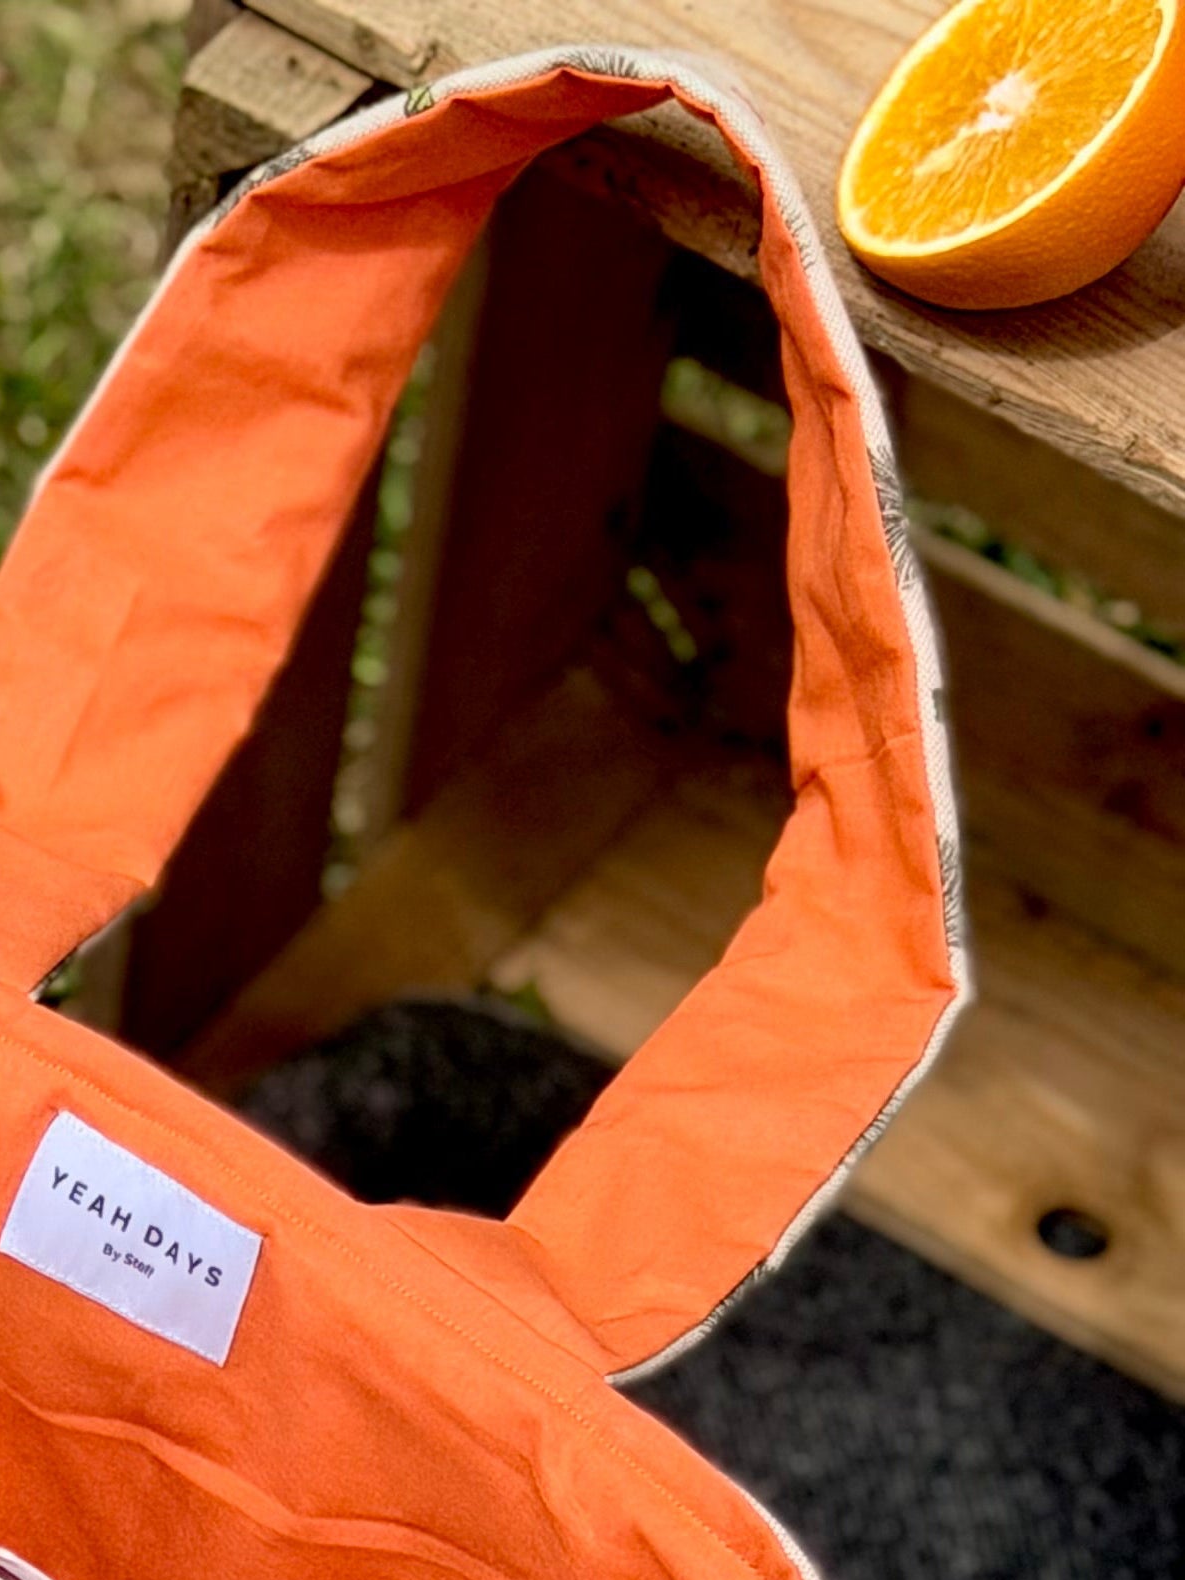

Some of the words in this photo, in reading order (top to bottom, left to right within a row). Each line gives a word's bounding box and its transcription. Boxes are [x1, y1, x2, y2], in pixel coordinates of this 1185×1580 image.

[51, 1166, 132, 1232] YEAH
[143, 1224, 223, 1287] DAYS
[102, 1242, 121, 1262] By
